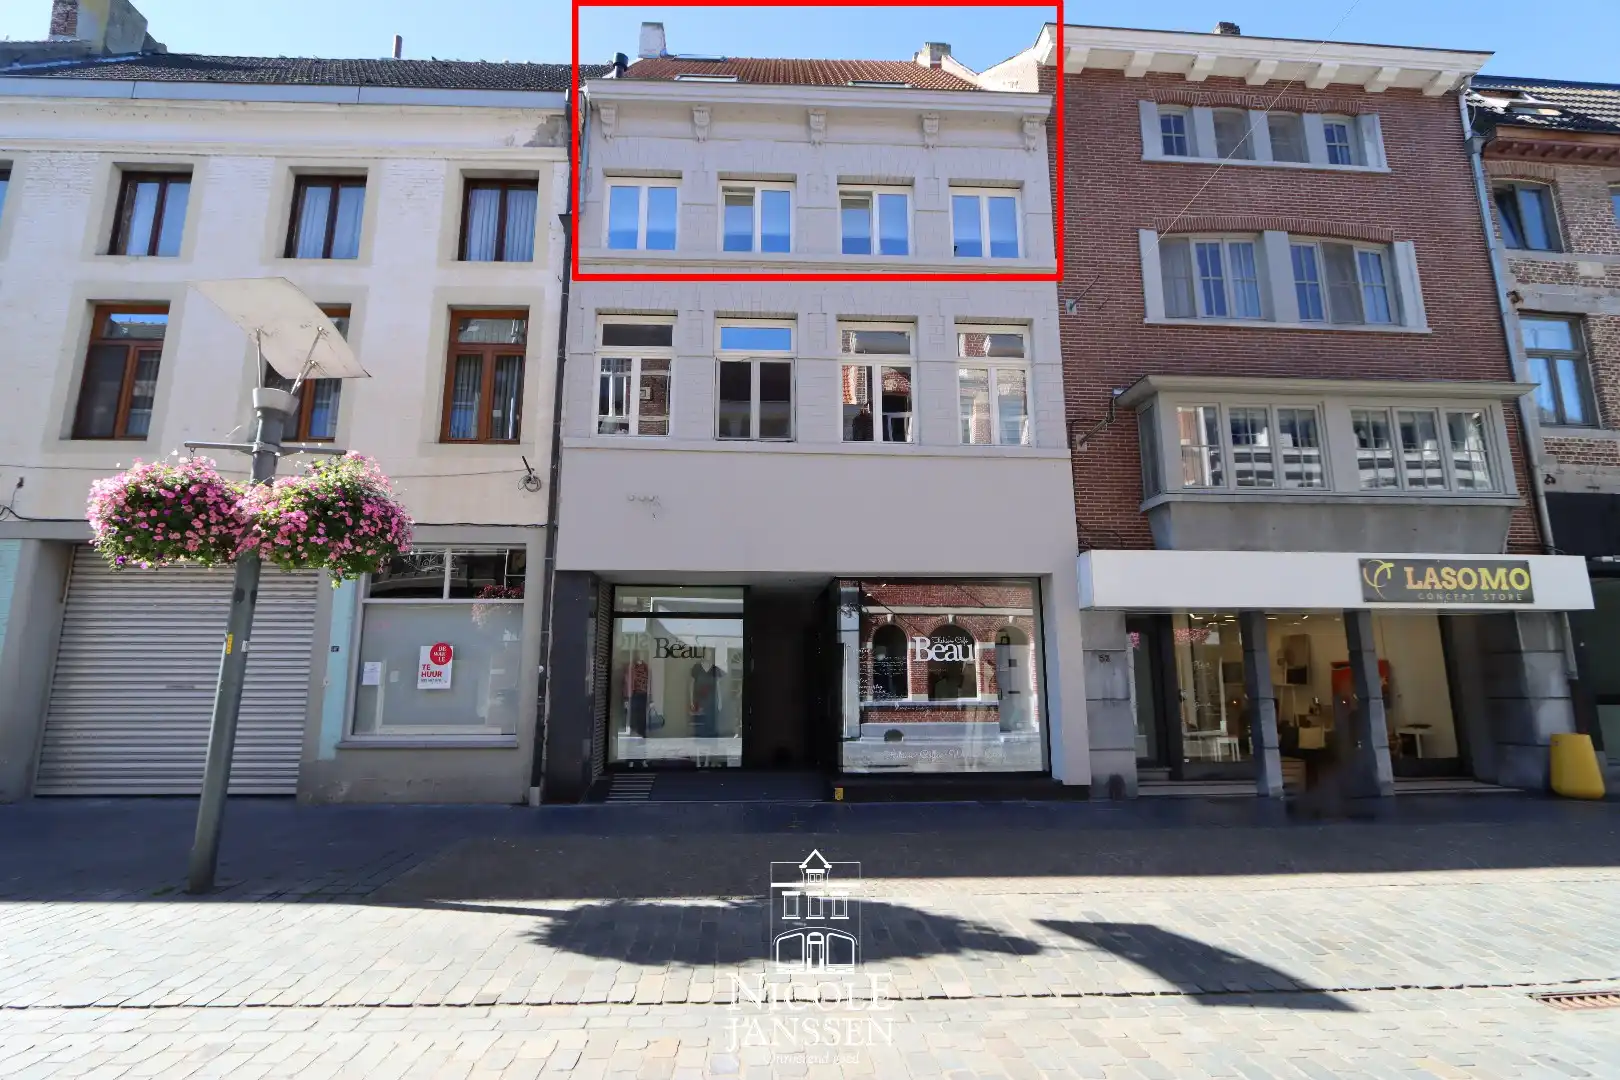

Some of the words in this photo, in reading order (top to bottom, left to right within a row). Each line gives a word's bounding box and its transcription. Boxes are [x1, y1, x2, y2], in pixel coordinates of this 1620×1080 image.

[1404, 566, 1530, 591] LASOMO
[1418, 592, 1475, 601] CONCEPT
[1483, 593, 1523, 601] STORE
[652, 637, 707, 659] Beau
[911, 636, 977, 661] Beau
